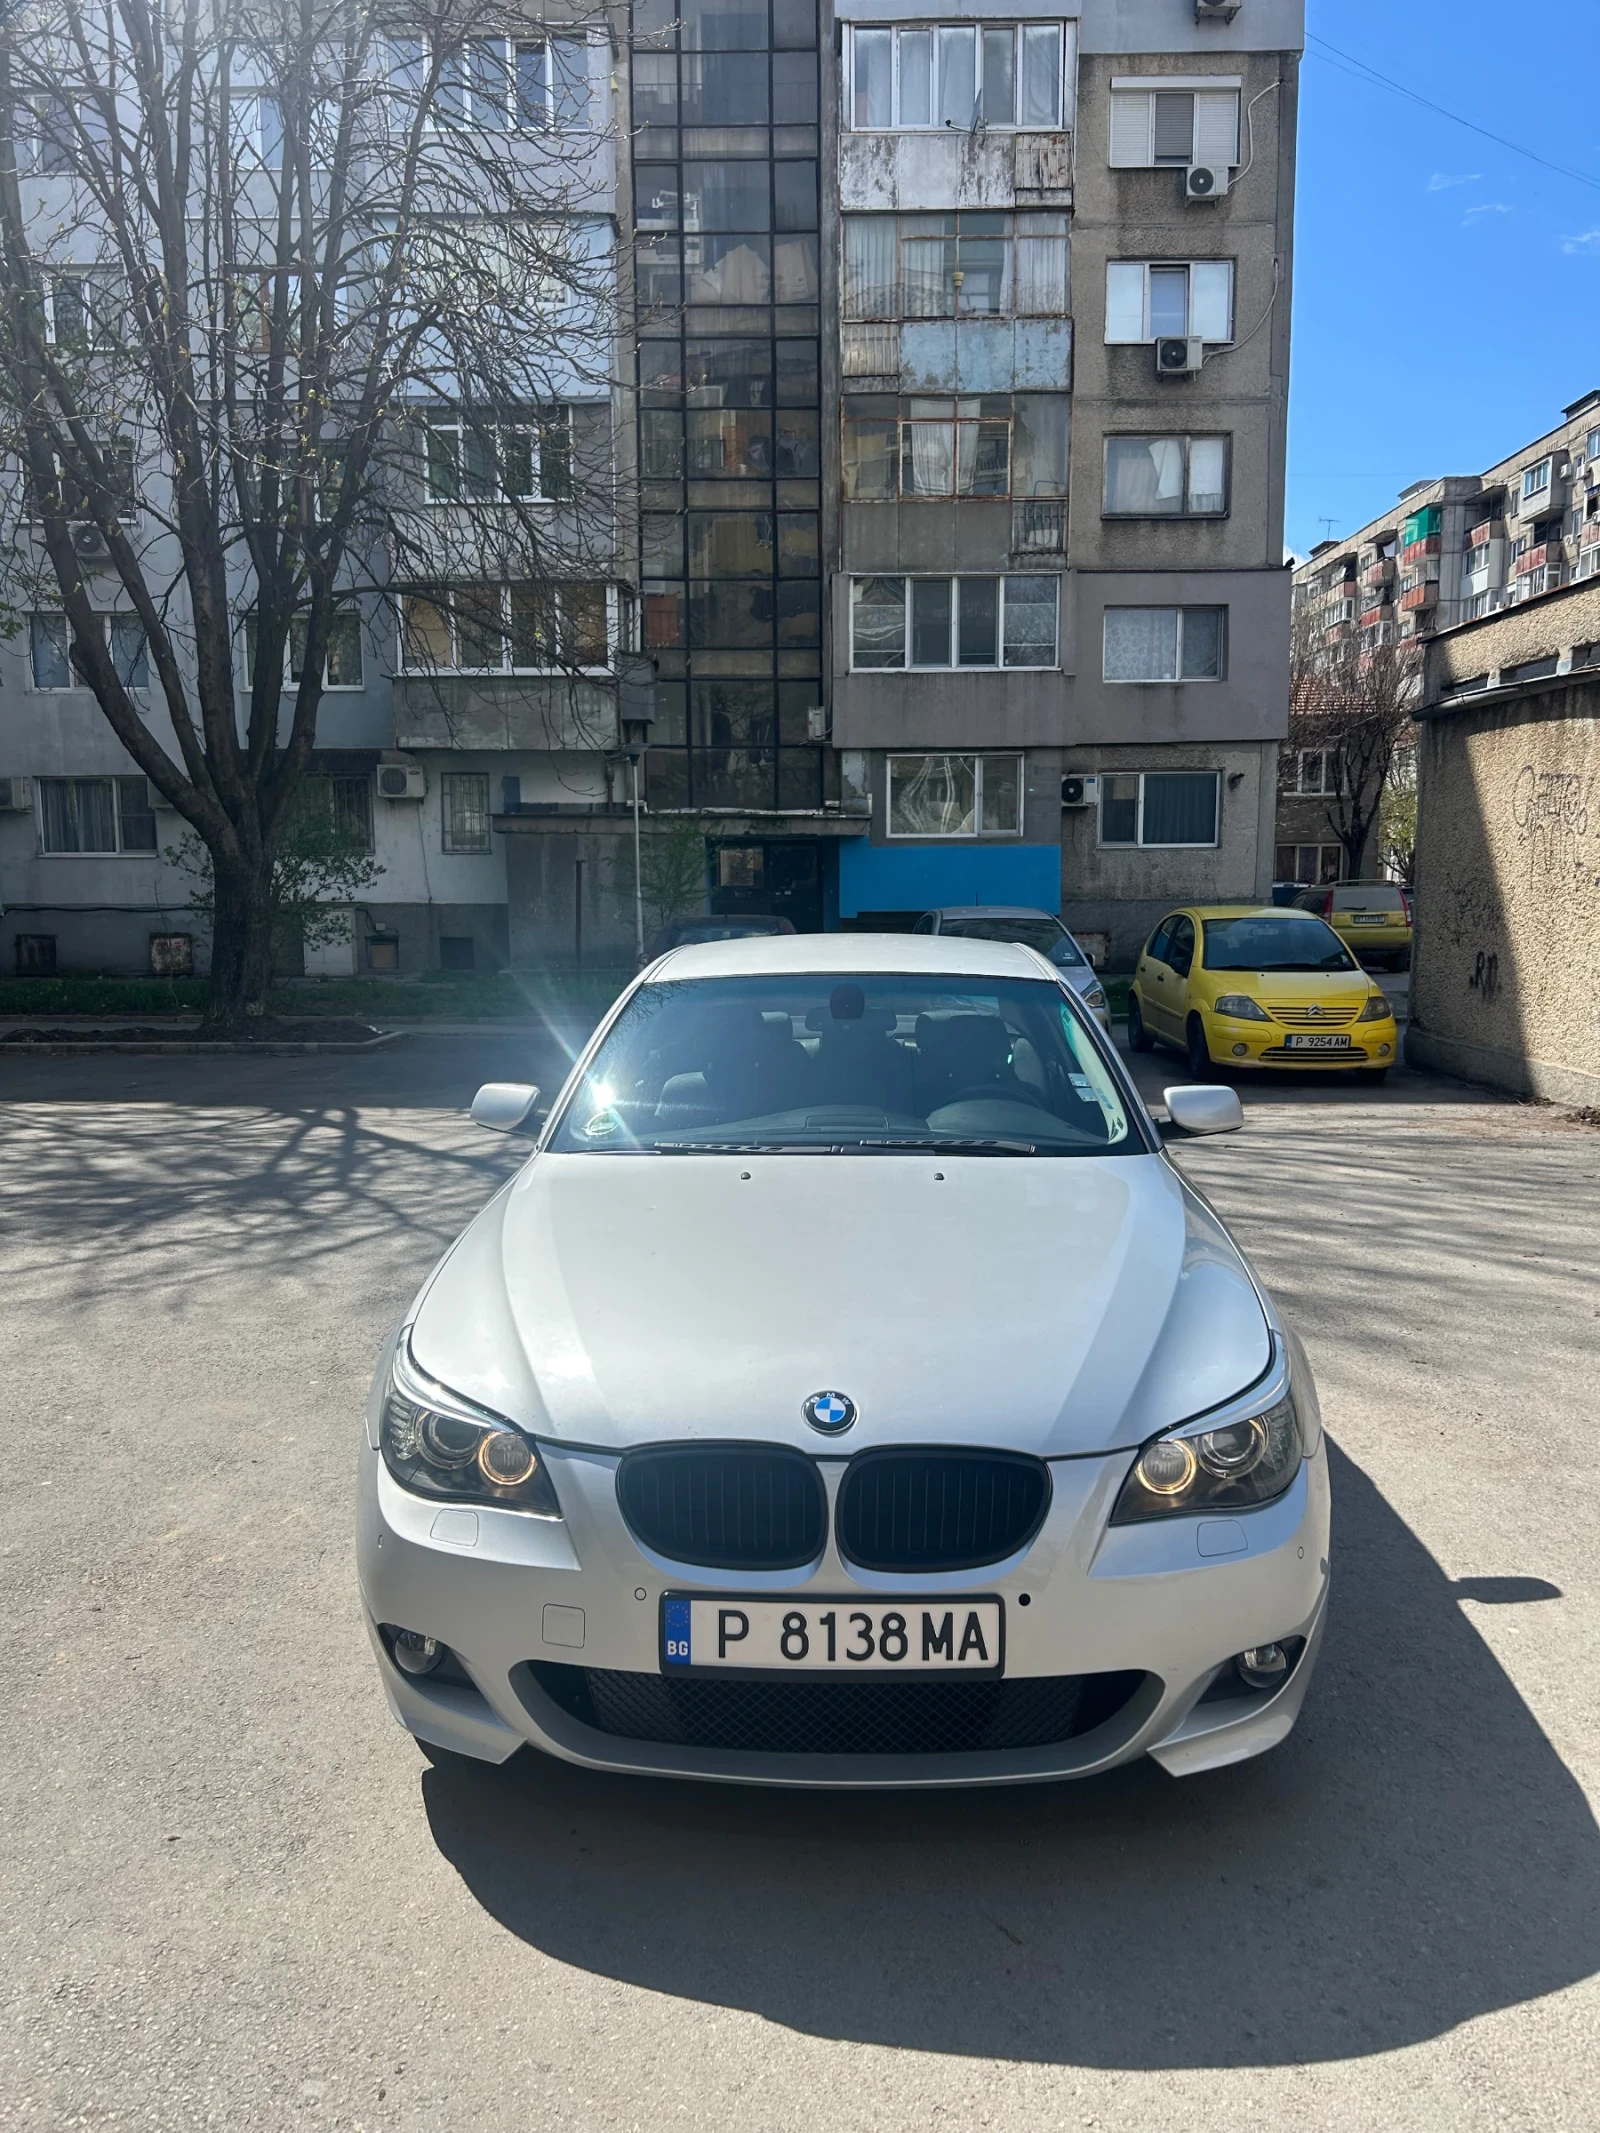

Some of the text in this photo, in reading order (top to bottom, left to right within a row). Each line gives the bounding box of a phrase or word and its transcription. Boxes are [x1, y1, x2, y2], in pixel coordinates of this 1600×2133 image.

[1295, 1036, 1303, 1047] P
[810, 1392, 851, 1405] BMW
[718, 1609, 749, 1659] P
[667, 1641, 689, 1656] BG
